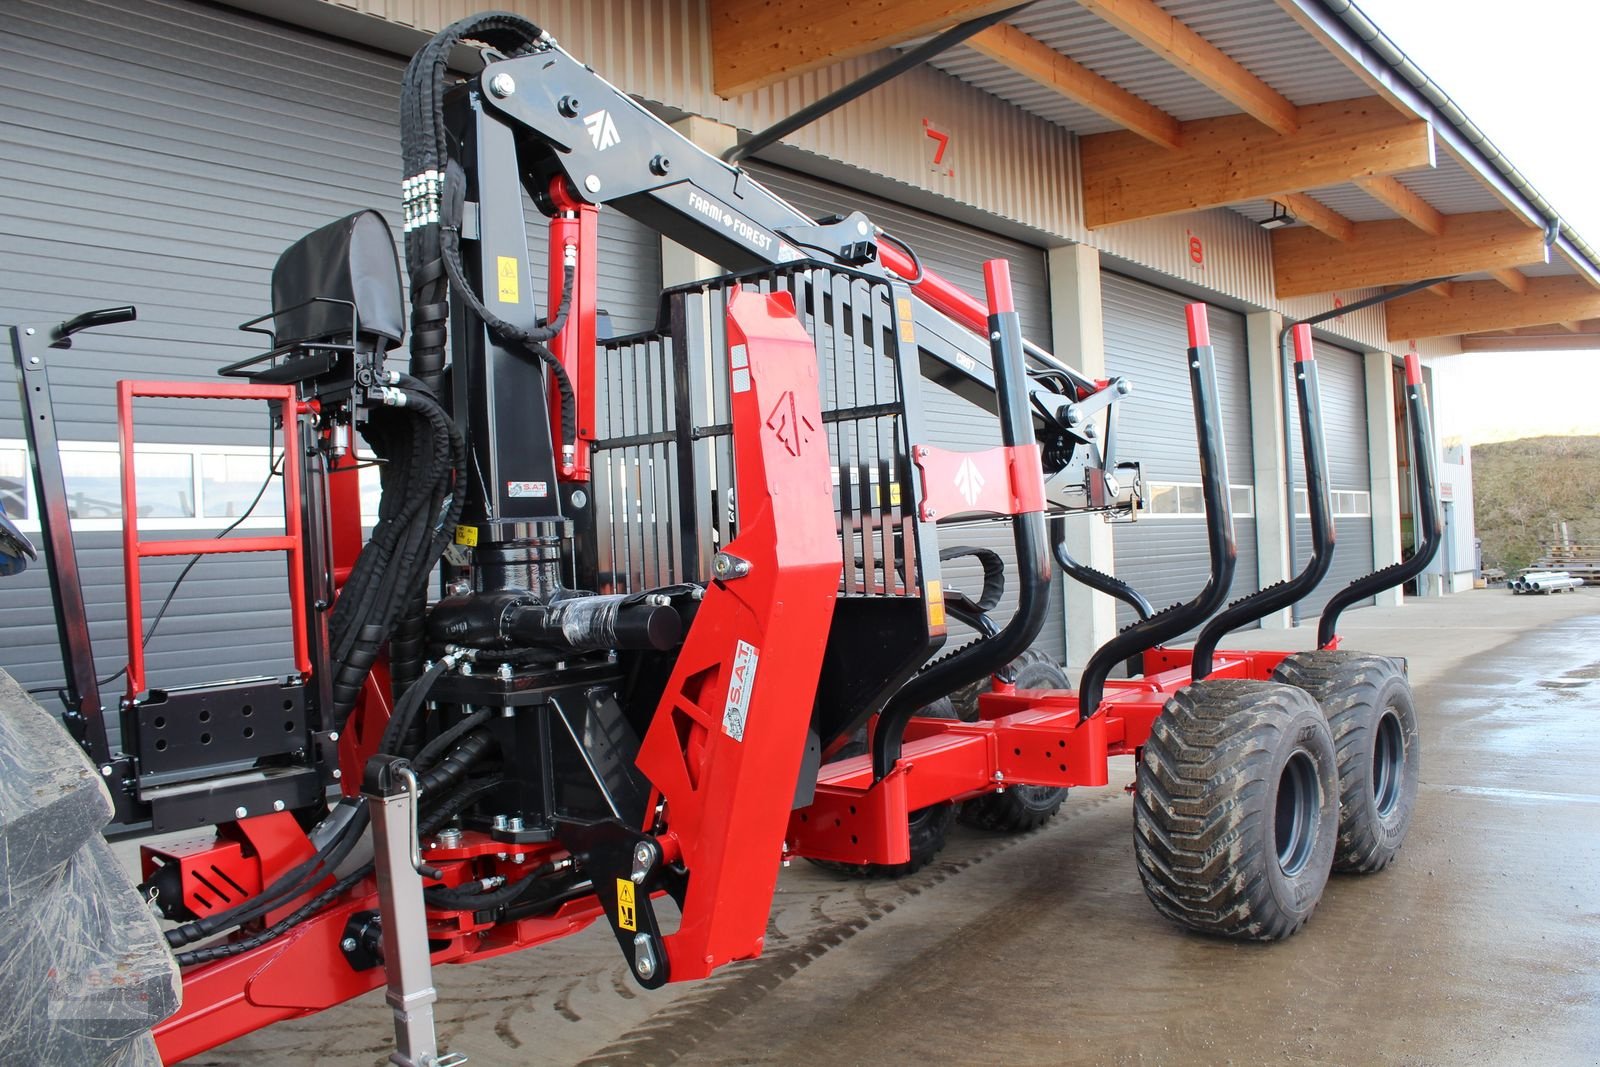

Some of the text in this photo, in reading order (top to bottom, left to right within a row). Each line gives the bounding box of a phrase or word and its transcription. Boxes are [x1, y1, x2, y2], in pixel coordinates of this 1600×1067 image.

[927, 128, 949, 164] 7
[689, 192, 772, 251] FARMI FOREST
[1190, 236, 1203, 263] 8
